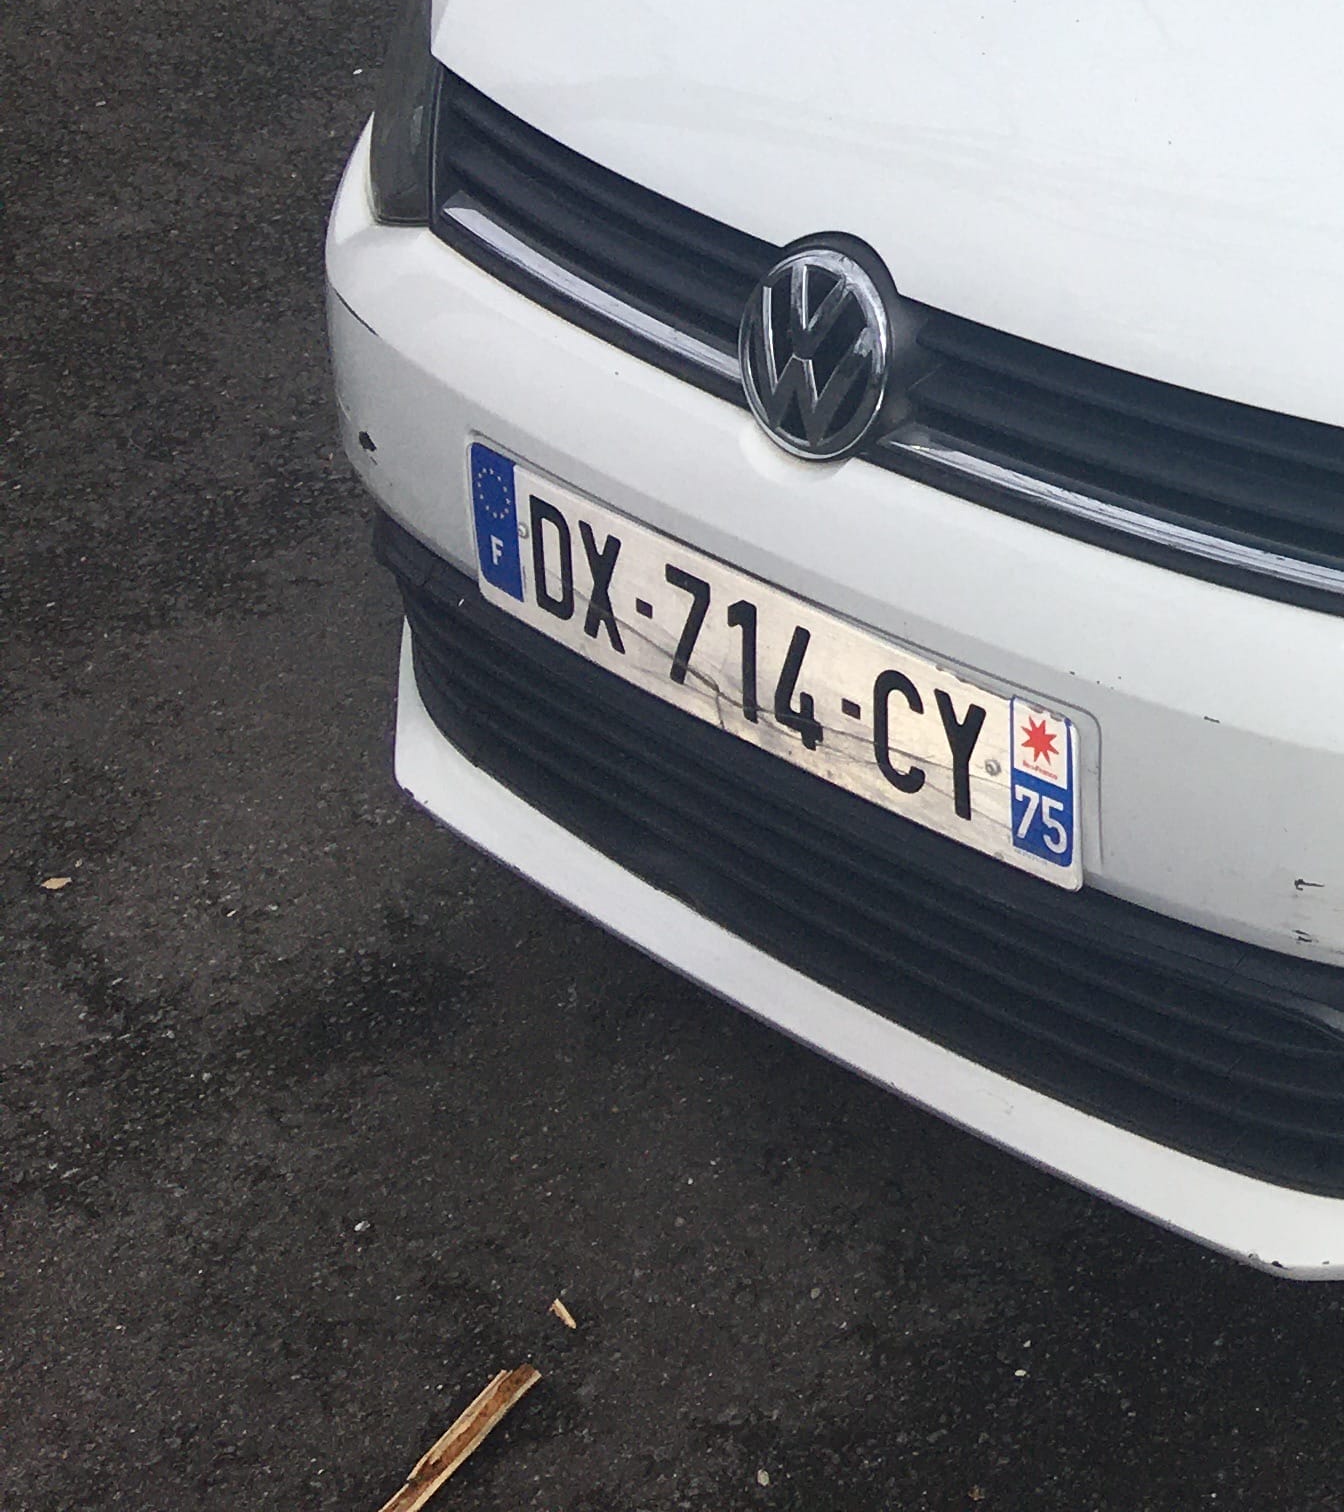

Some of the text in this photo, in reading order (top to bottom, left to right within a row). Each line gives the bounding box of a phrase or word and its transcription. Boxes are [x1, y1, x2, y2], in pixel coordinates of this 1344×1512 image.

[490, 534, 504, 566] F
[529, 494, 987, 821] DX-714-CY
[1015, 784, 1068, 855] 75
